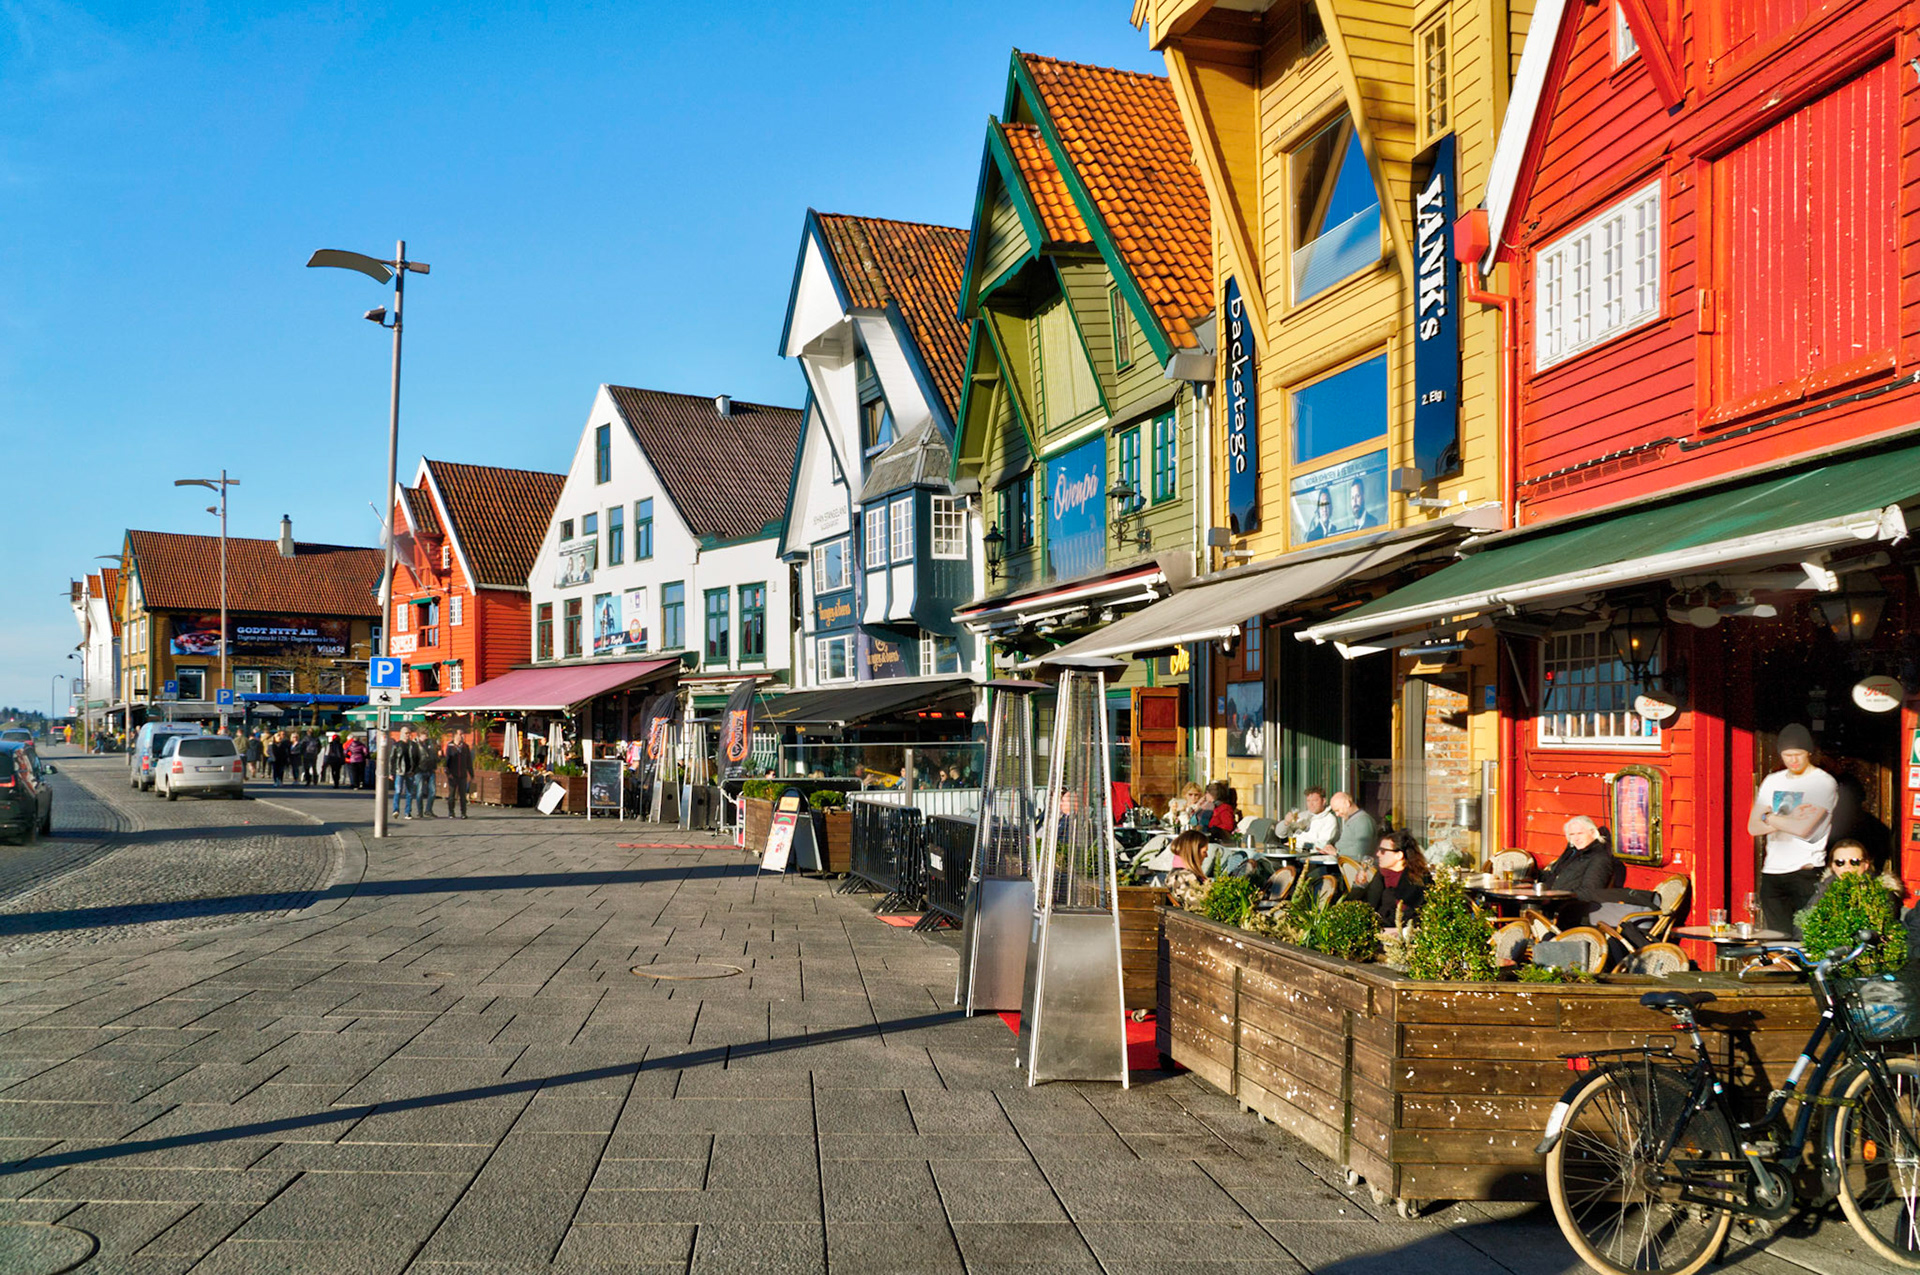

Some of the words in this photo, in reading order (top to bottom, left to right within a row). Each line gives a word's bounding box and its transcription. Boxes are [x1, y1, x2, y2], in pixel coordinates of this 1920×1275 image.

[1229, 295, 1252, 474] backstage
[236, 626, 268, 635] GODT
[269, 627, 298, 636] NYTT
[299, 627, 318, 637] ÅR!
[377, 660, 394, 683] P
[220, 691, 230, 703] P
